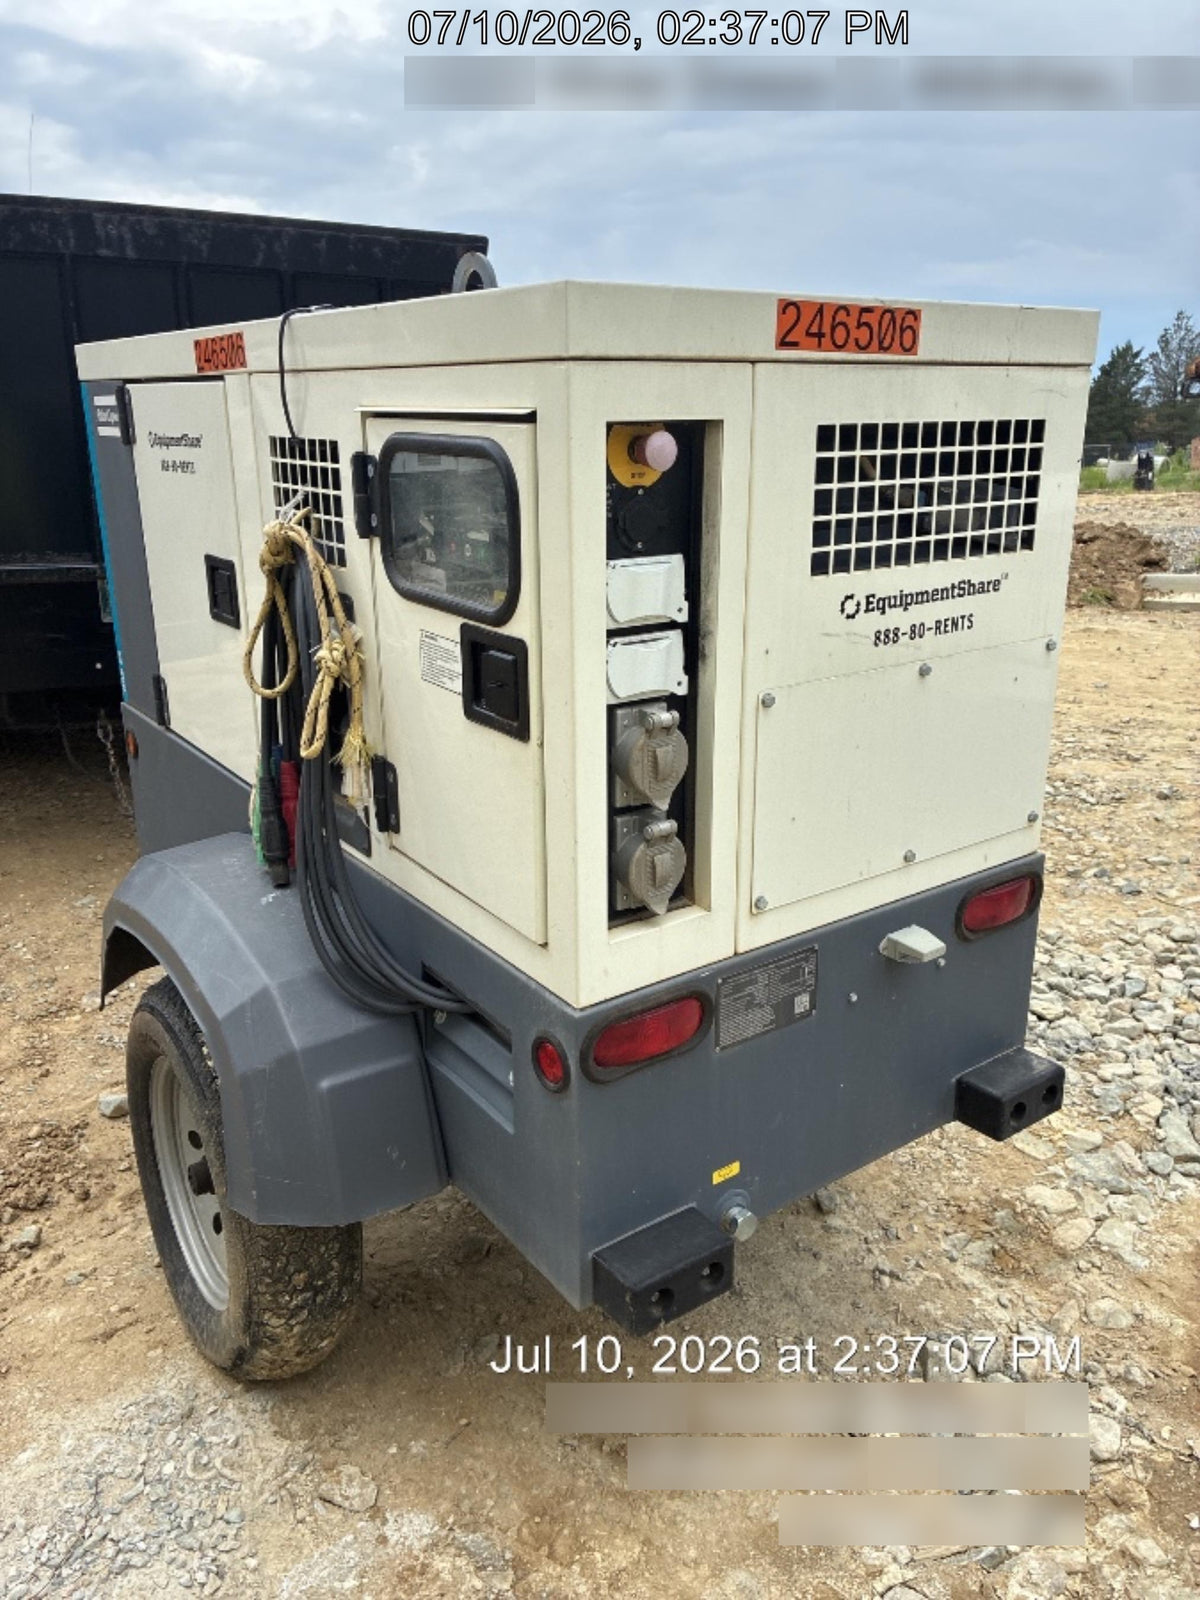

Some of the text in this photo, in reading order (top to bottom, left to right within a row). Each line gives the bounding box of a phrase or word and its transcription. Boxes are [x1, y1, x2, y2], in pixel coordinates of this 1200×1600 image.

[779, 301, 919, 352] 246506
[863, 577, 1001, 616] EquipmentShare
[873, 613, 974, 647] 888-80-RENTS
